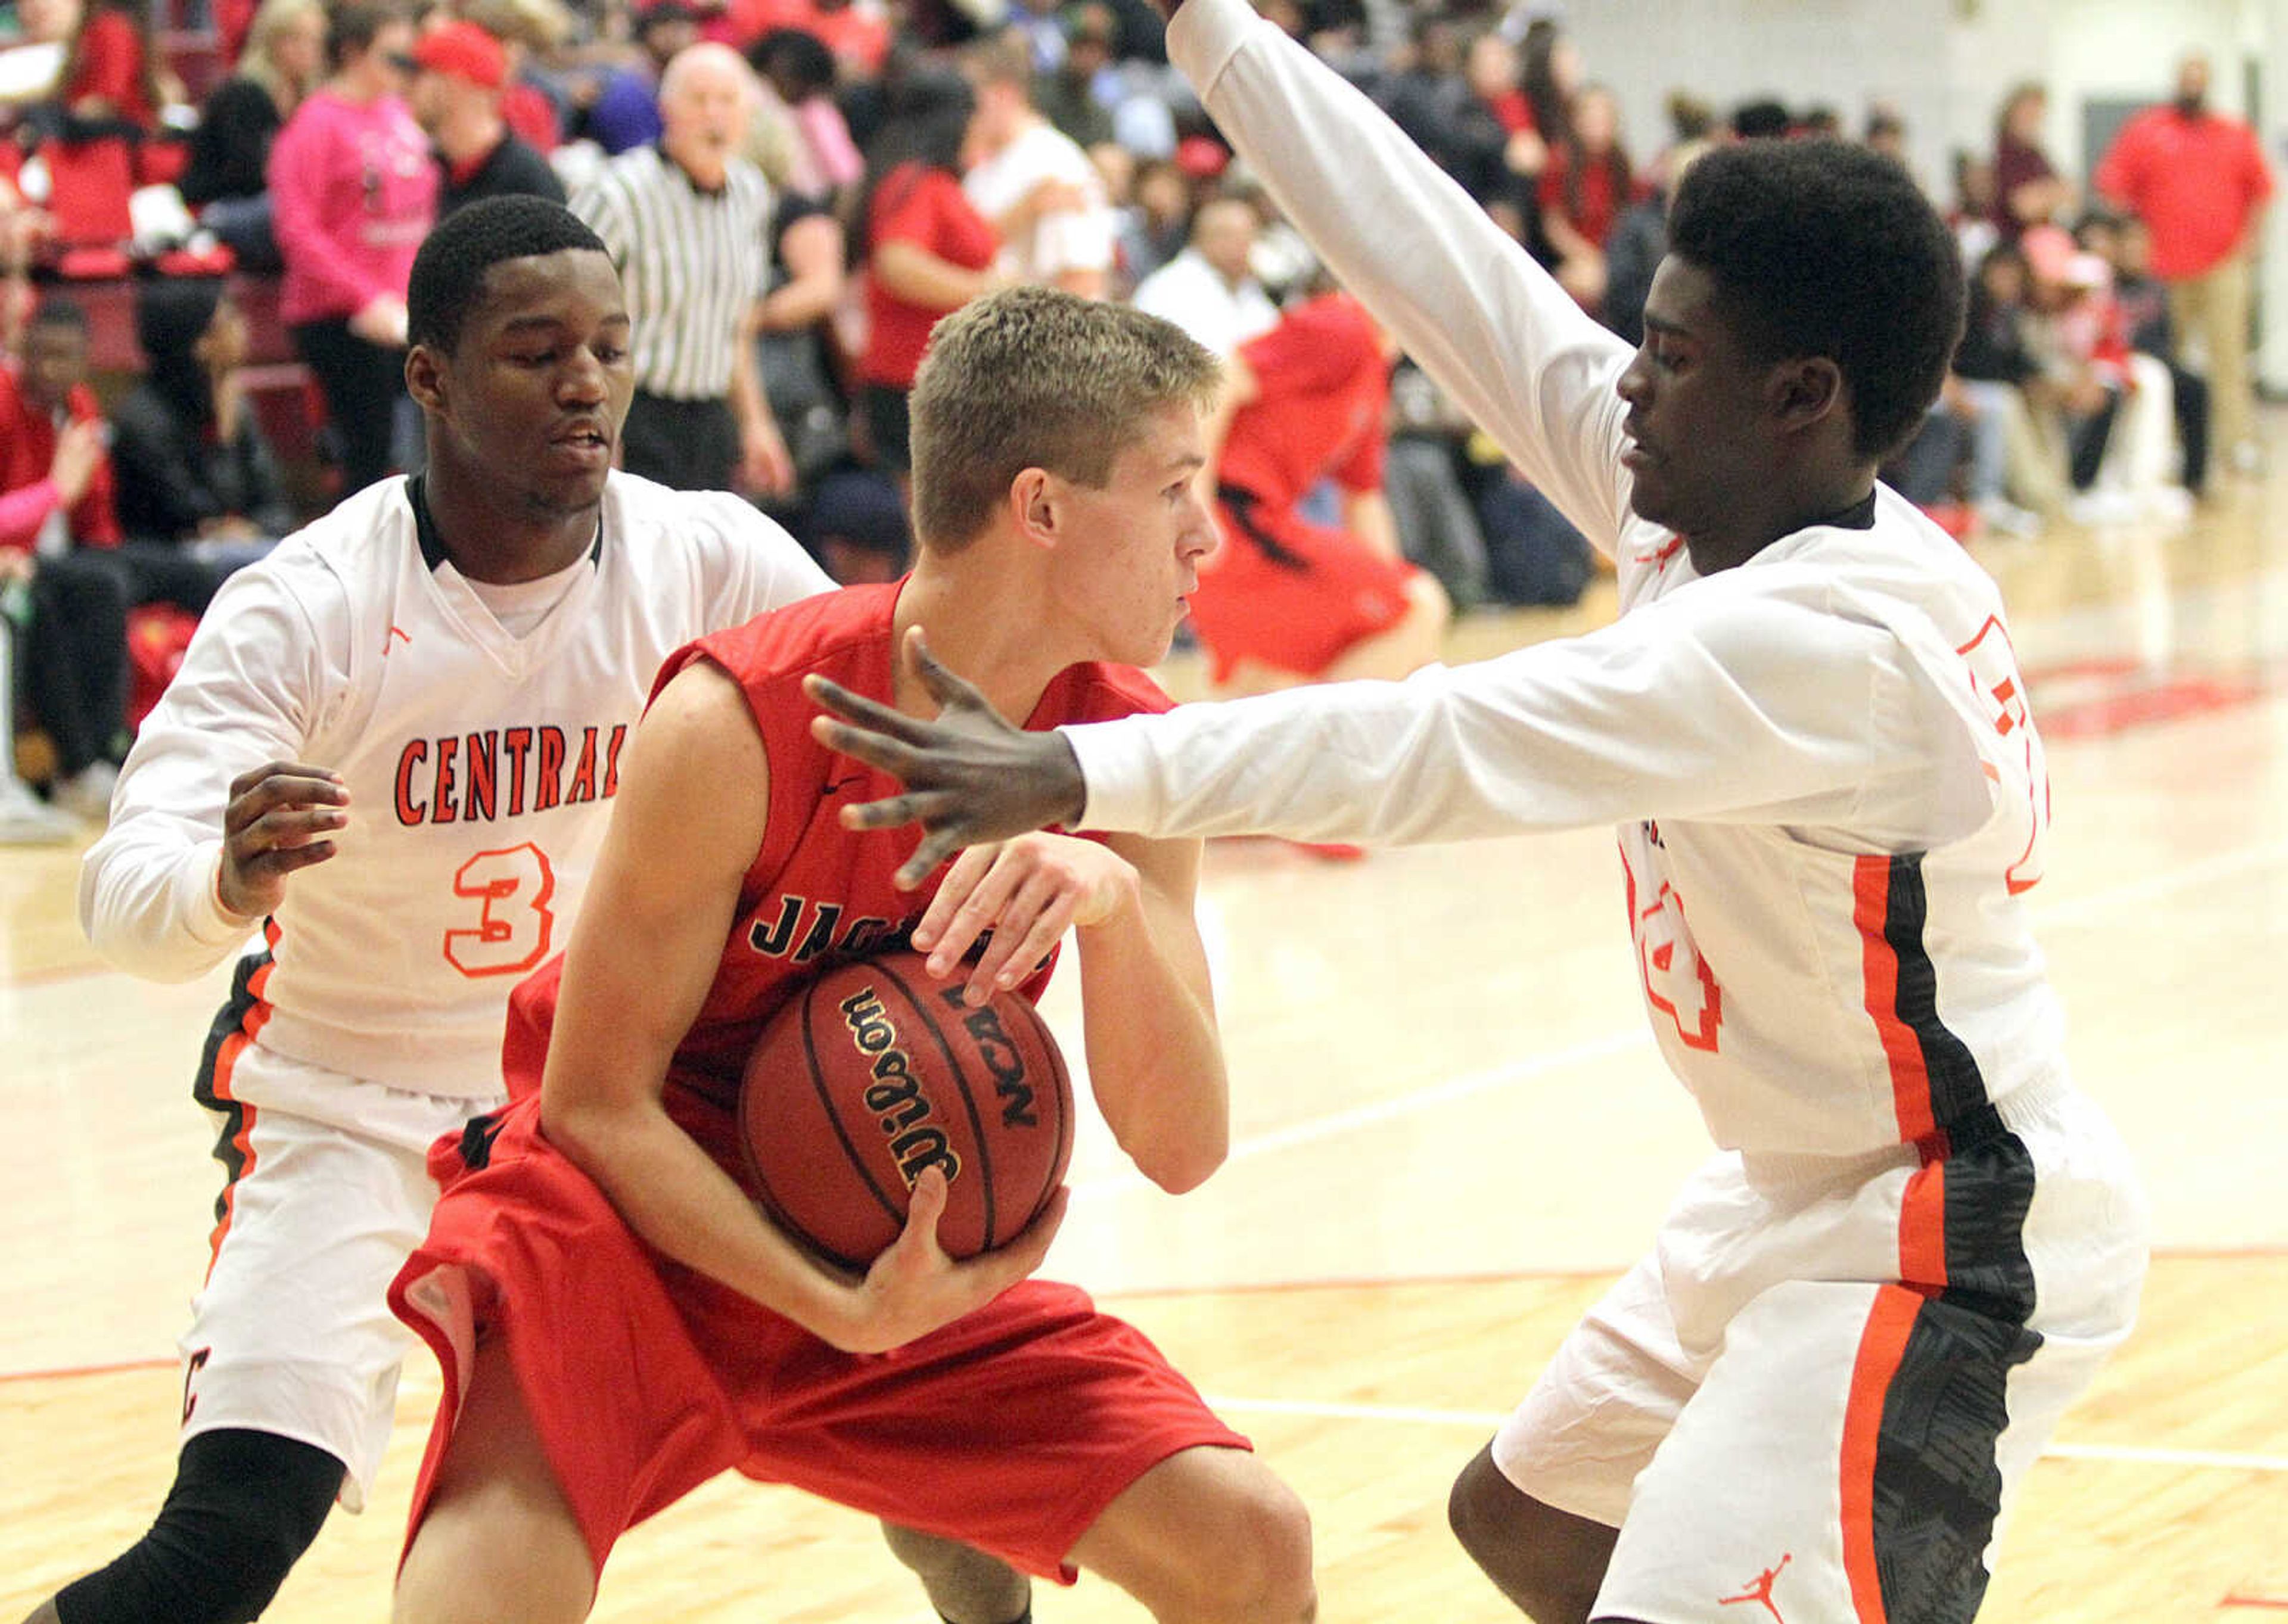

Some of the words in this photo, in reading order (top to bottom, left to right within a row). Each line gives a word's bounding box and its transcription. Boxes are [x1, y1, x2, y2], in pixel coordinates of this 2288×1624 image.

[394, 723, 627, 826] CENTRAL
[443, 841, 555, 979] 3
[838, 984, 962, 1193] Wilson
